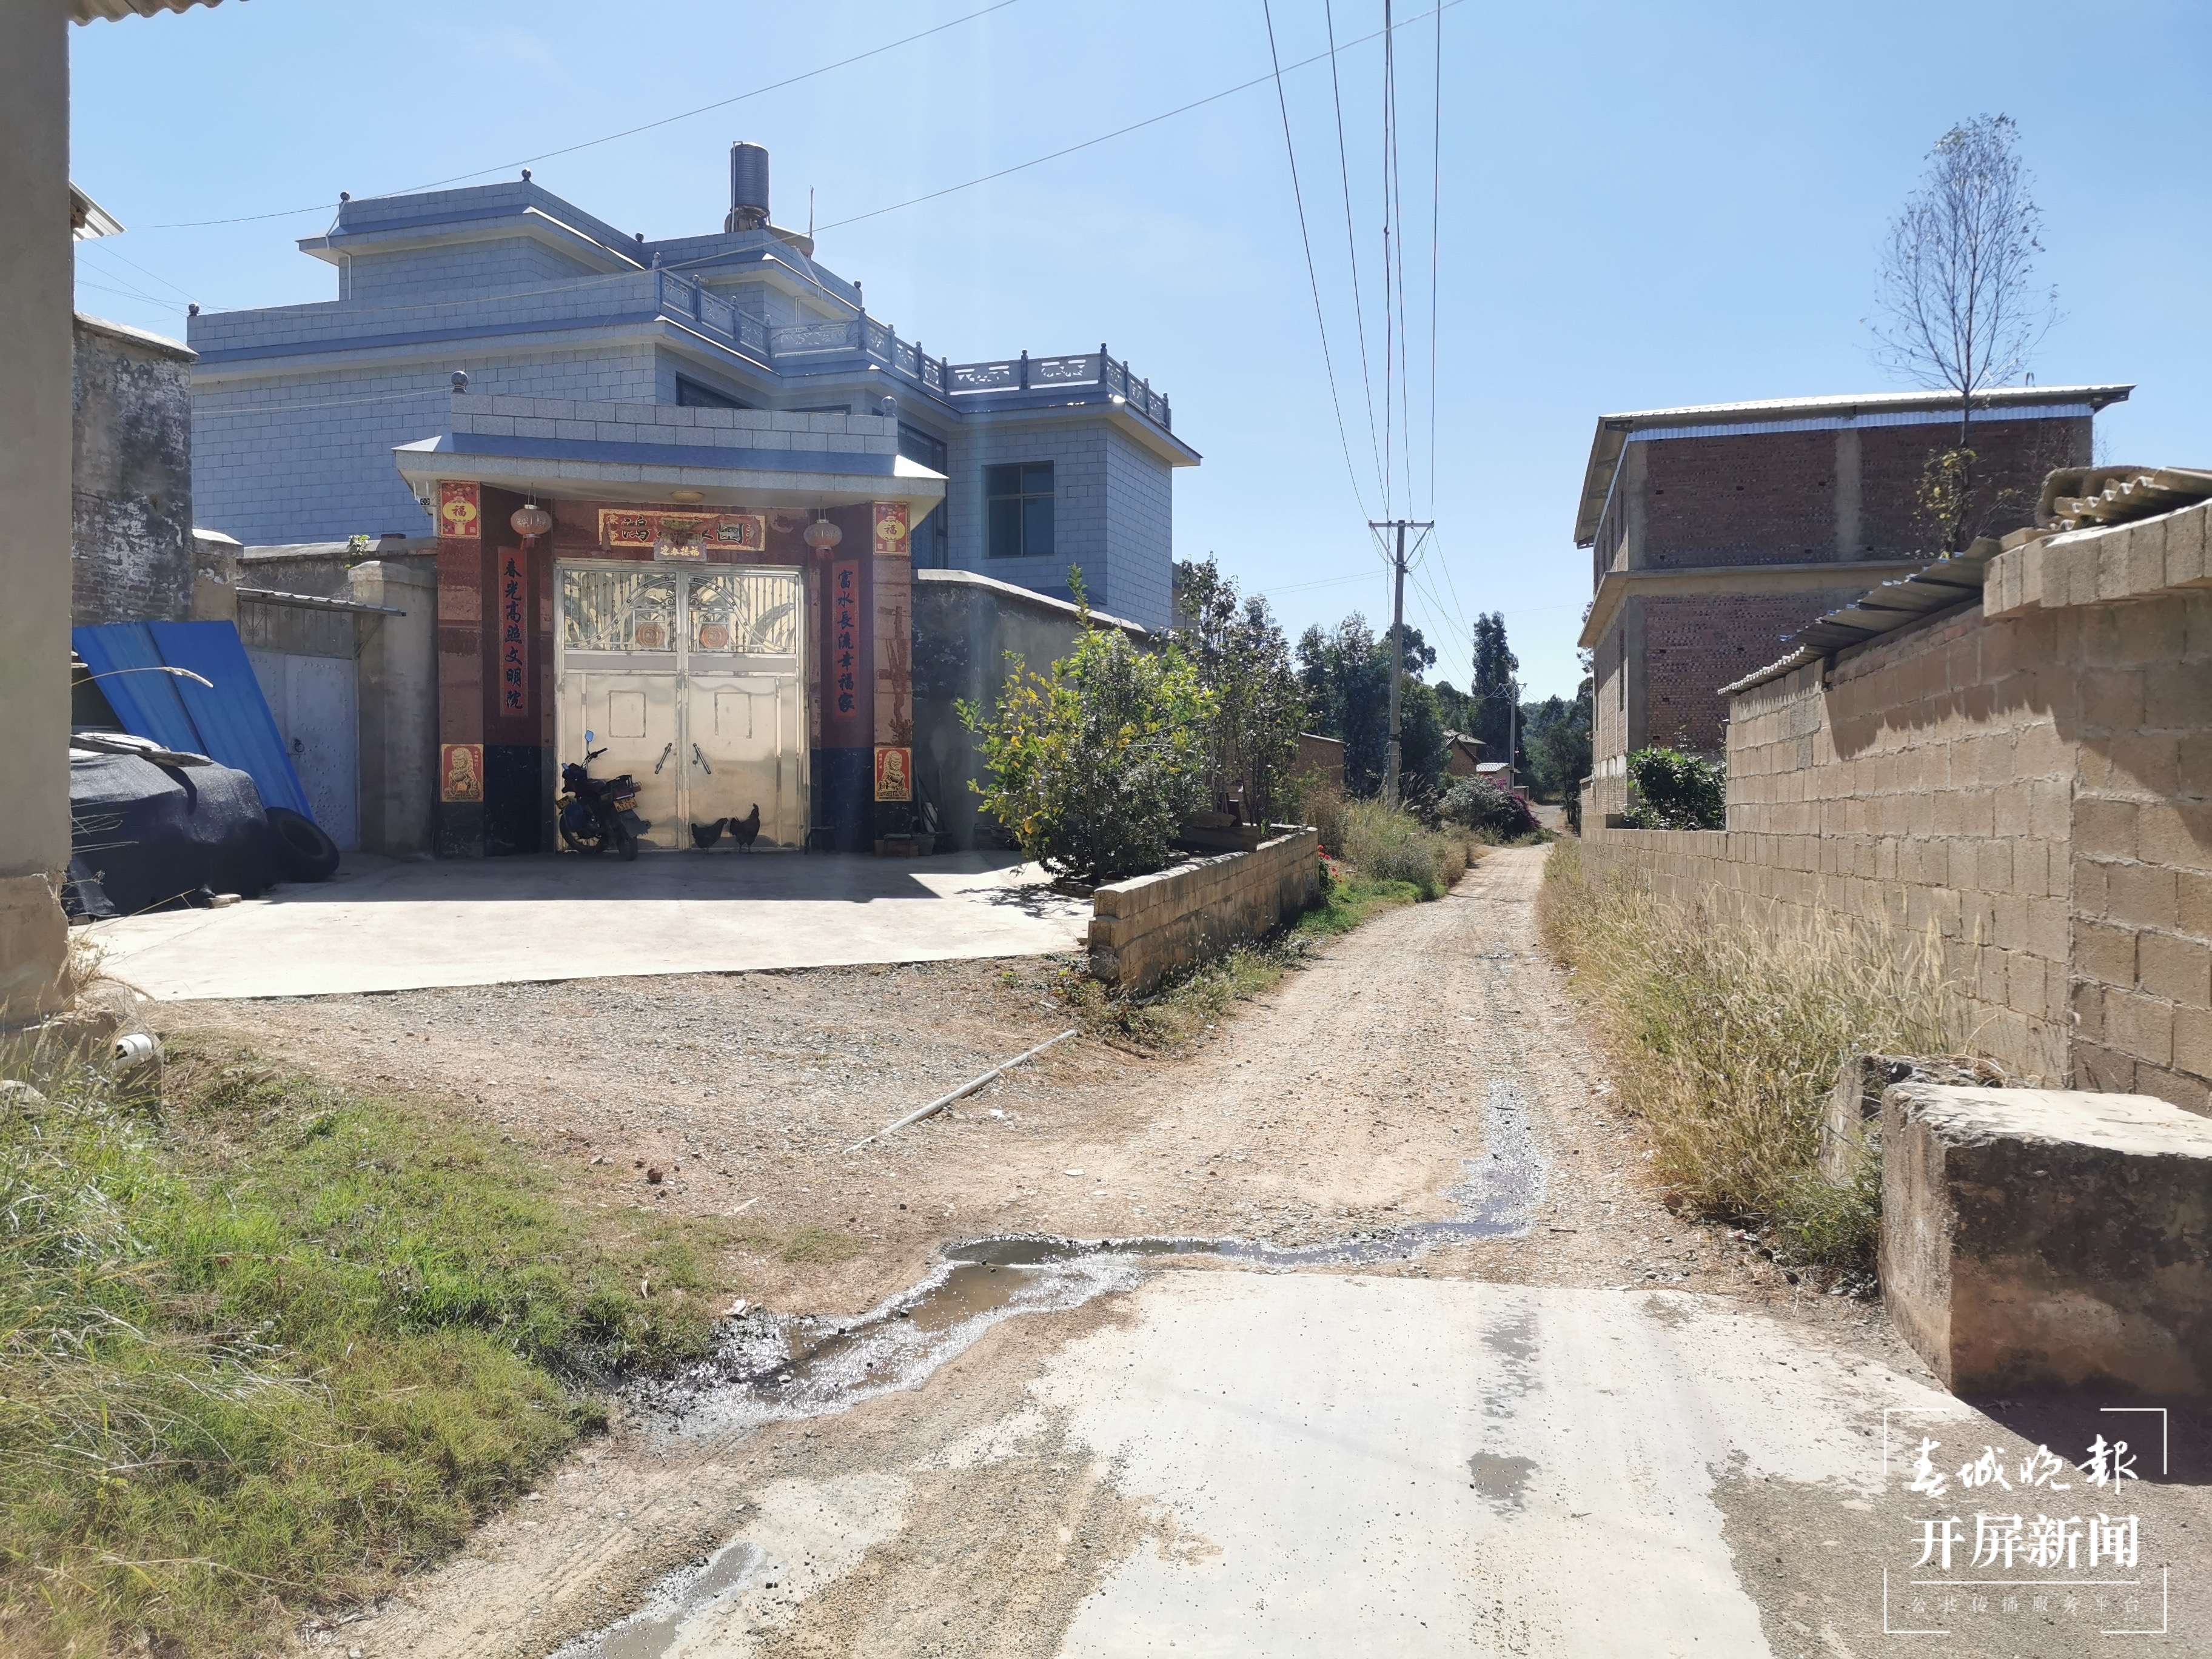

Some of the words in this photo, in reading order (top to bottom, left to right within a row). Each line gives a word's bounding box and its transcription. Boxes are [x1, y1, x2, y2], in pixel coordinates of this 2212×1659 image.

[451, 504, 467, 517] 福
[883, 524, 897, 535] 福
[503, 557, 523, 709] 春光高照文明院
